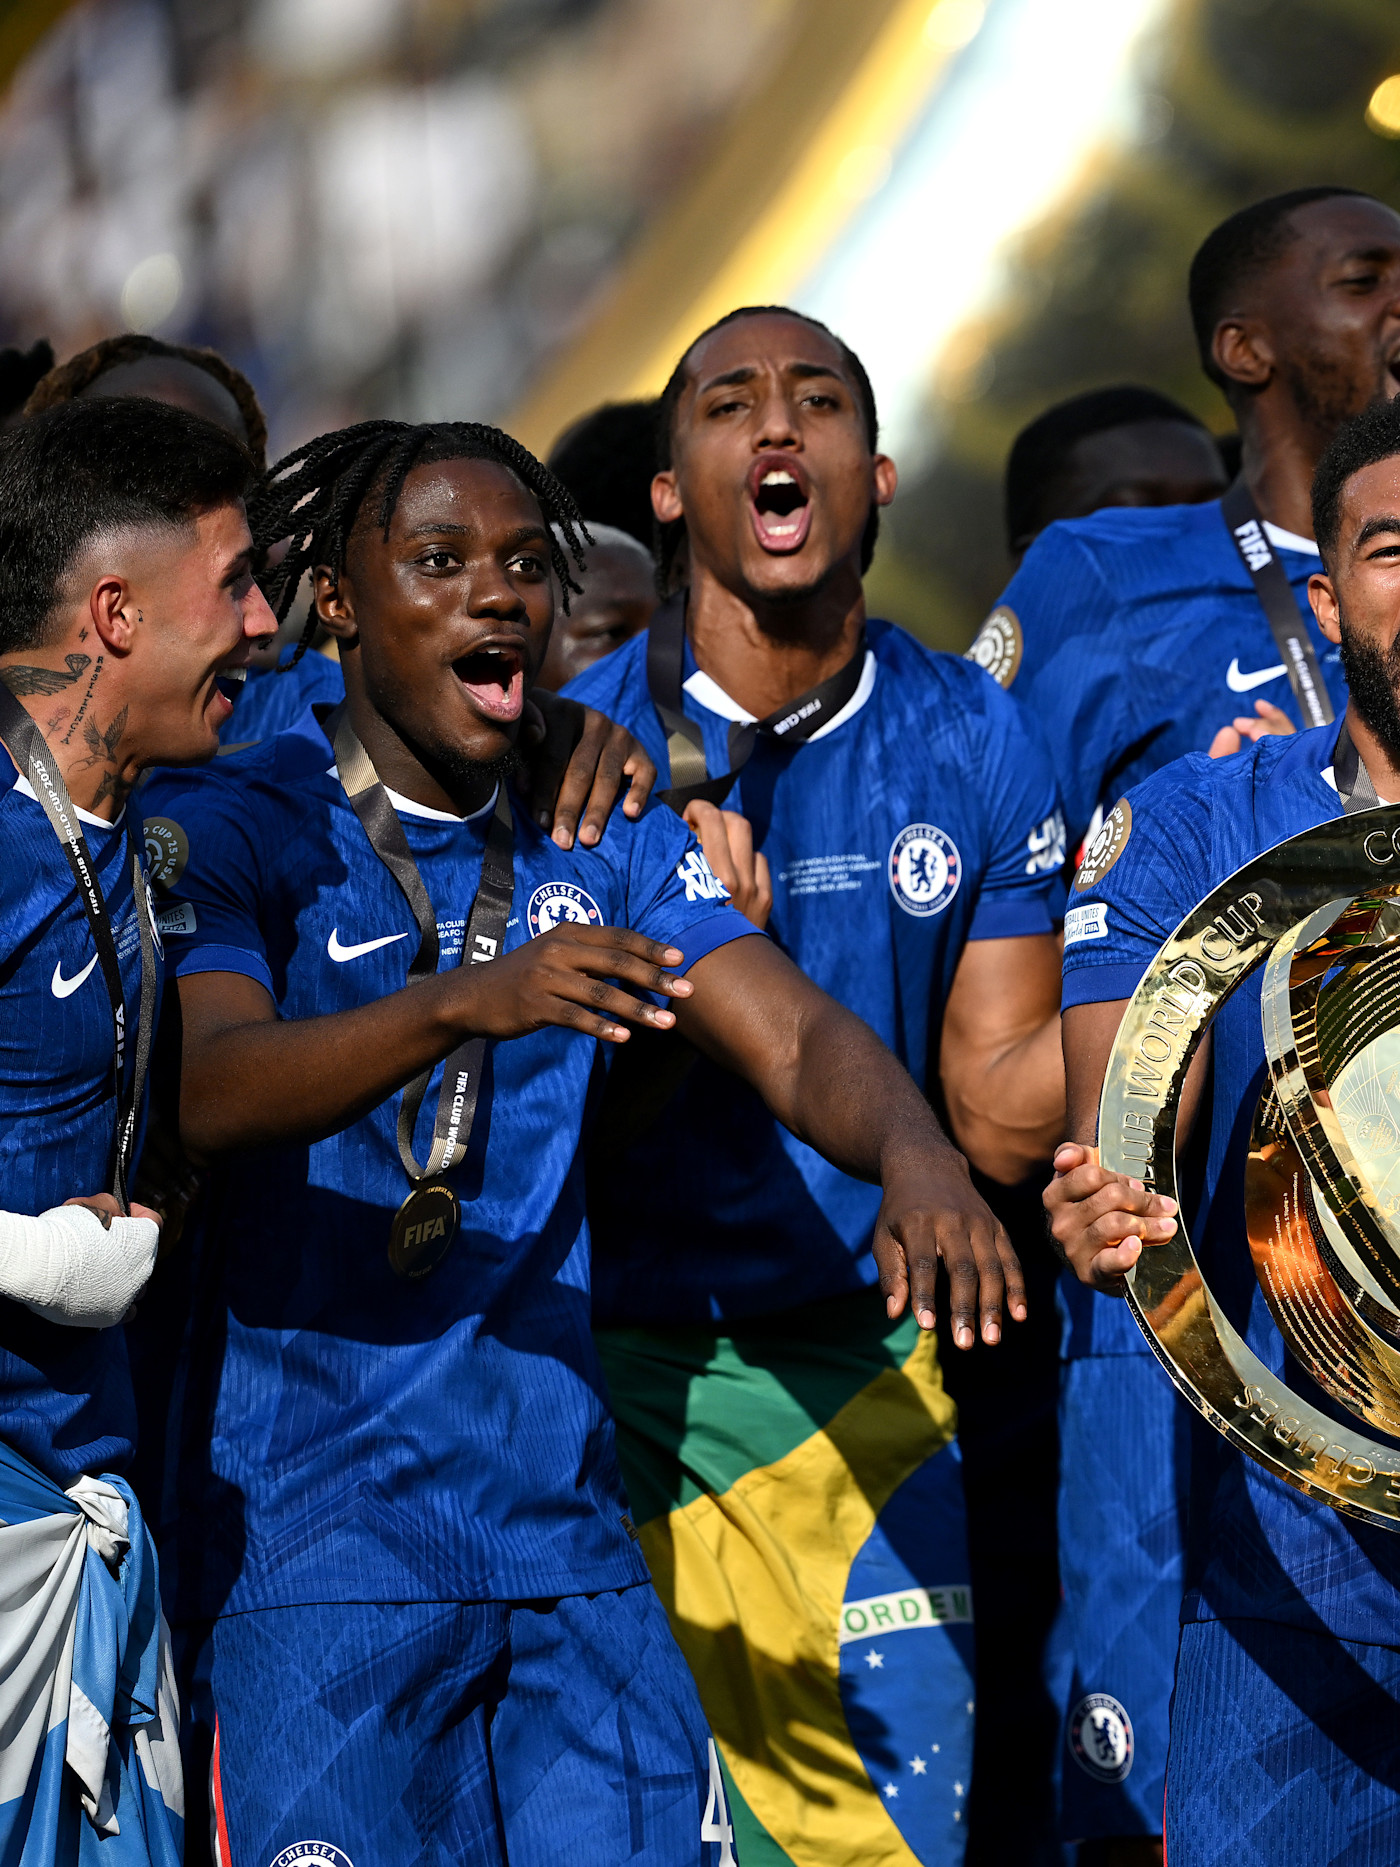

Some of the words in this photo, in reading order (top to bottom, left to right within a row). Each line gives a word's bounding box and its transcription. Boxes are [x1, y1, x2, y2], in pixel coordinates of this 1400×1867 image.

[1234, 519, 1273, 572] FIFA
[49, 790, 64, 812] CUP
[60, 814, 81, 857] WORLD
[151, 825, 173, 840] CUP
[168, 840, 178, 854] 25
[77, 857, 92, 887] CLUB
[158, 858, 177, 881] USA
[1078, 870, 1097, 884] FIFA
[88, 888, 101, 915] FIFA
[534, 885, 582, 906] CHELSEA
[159, 909, 186, 924] NITES
[162, 924, 186, 932] FIFA
[445, 920, 465, 928] CLUB
[1085, 923, 1099, 933] FIFA
[1199, 891, 1264, 962] CUP
[116, 1003, 124, 1069] FIFA
[1127, 960, 1209, 1098] WORLD
[456, 1071, 468, 1093] FIFA
[450, 1095, 464, 1125] CLUB
[441, 1126, 459, 1169] WORLD
[1121, 1111, 1156, 1190] LUB
[403, 1216, 446, 1248] FIFA
[1233, 1385, 1377, 1485] CLUBES
[278, 1844, 336, 1867] CHELSEA
